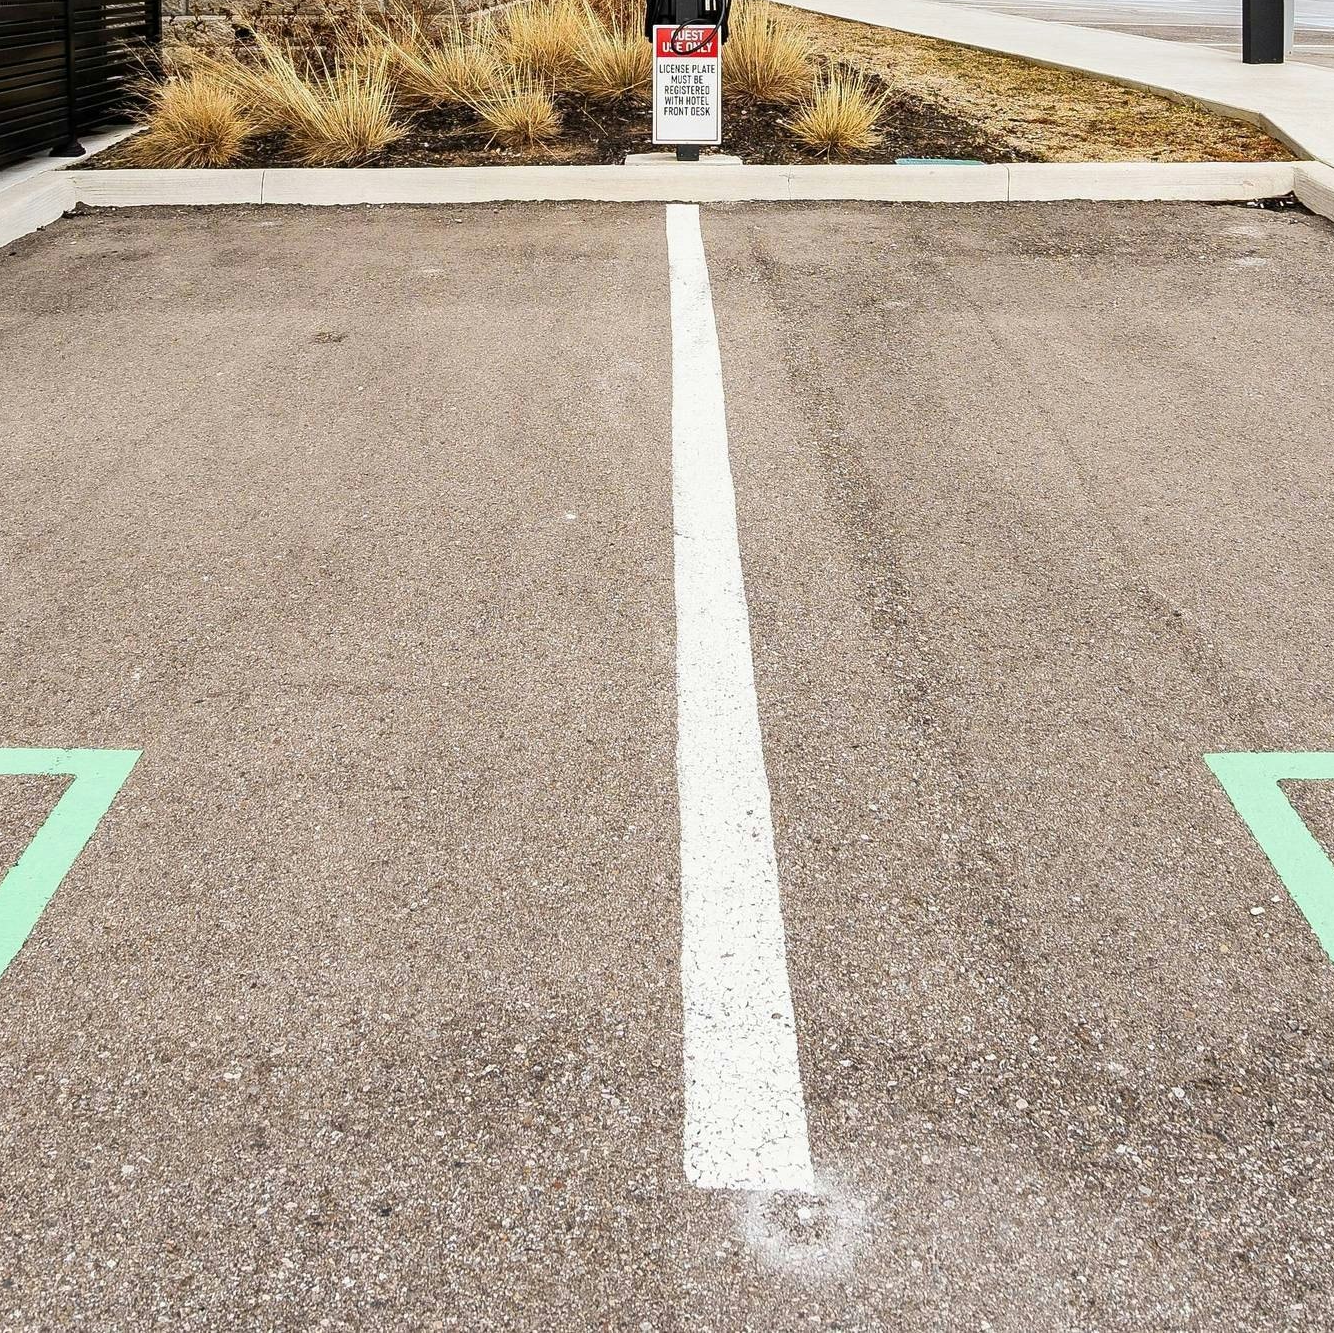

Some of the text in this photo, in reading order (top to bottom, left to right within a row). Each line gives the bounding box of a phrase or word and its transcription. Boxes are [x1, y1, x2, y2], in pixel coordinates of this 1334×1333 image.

[659, 64, 716, 74] LICENSE PLATE
[671, 75, 704, 84] MUST BE
[664, 85, 710, 95] REGISTERED
[664, 96, 710, 106] WITH HOTEL
[663, 106, 711, 116] FRONT DESK
